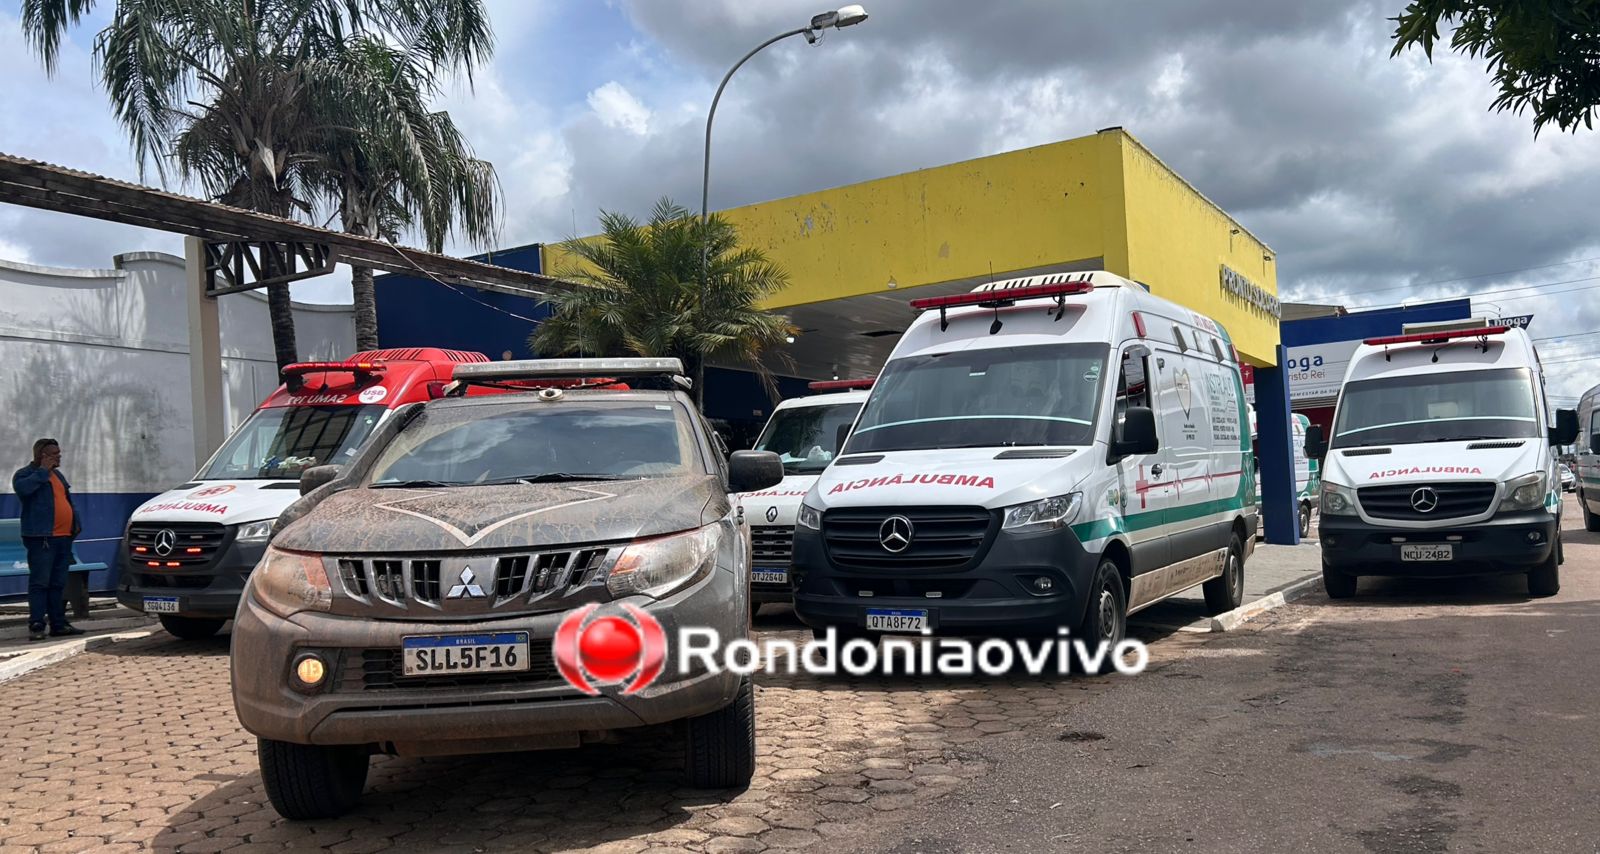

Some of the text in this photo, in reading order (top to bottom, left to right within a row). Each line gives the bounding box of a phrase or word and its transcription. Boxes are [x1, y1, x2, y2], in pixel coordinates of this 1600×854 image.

[1220, 264, 1251, 303] PRONTO
[1494, 316, 1528, 328] Droga
[1287, 355, 1324, 371] oga
[1288, 369, 1326, 381] risto Rei
[872, 616, 921, 629] QTA8F72
[416, 646, 517, 671] SLL5F16
